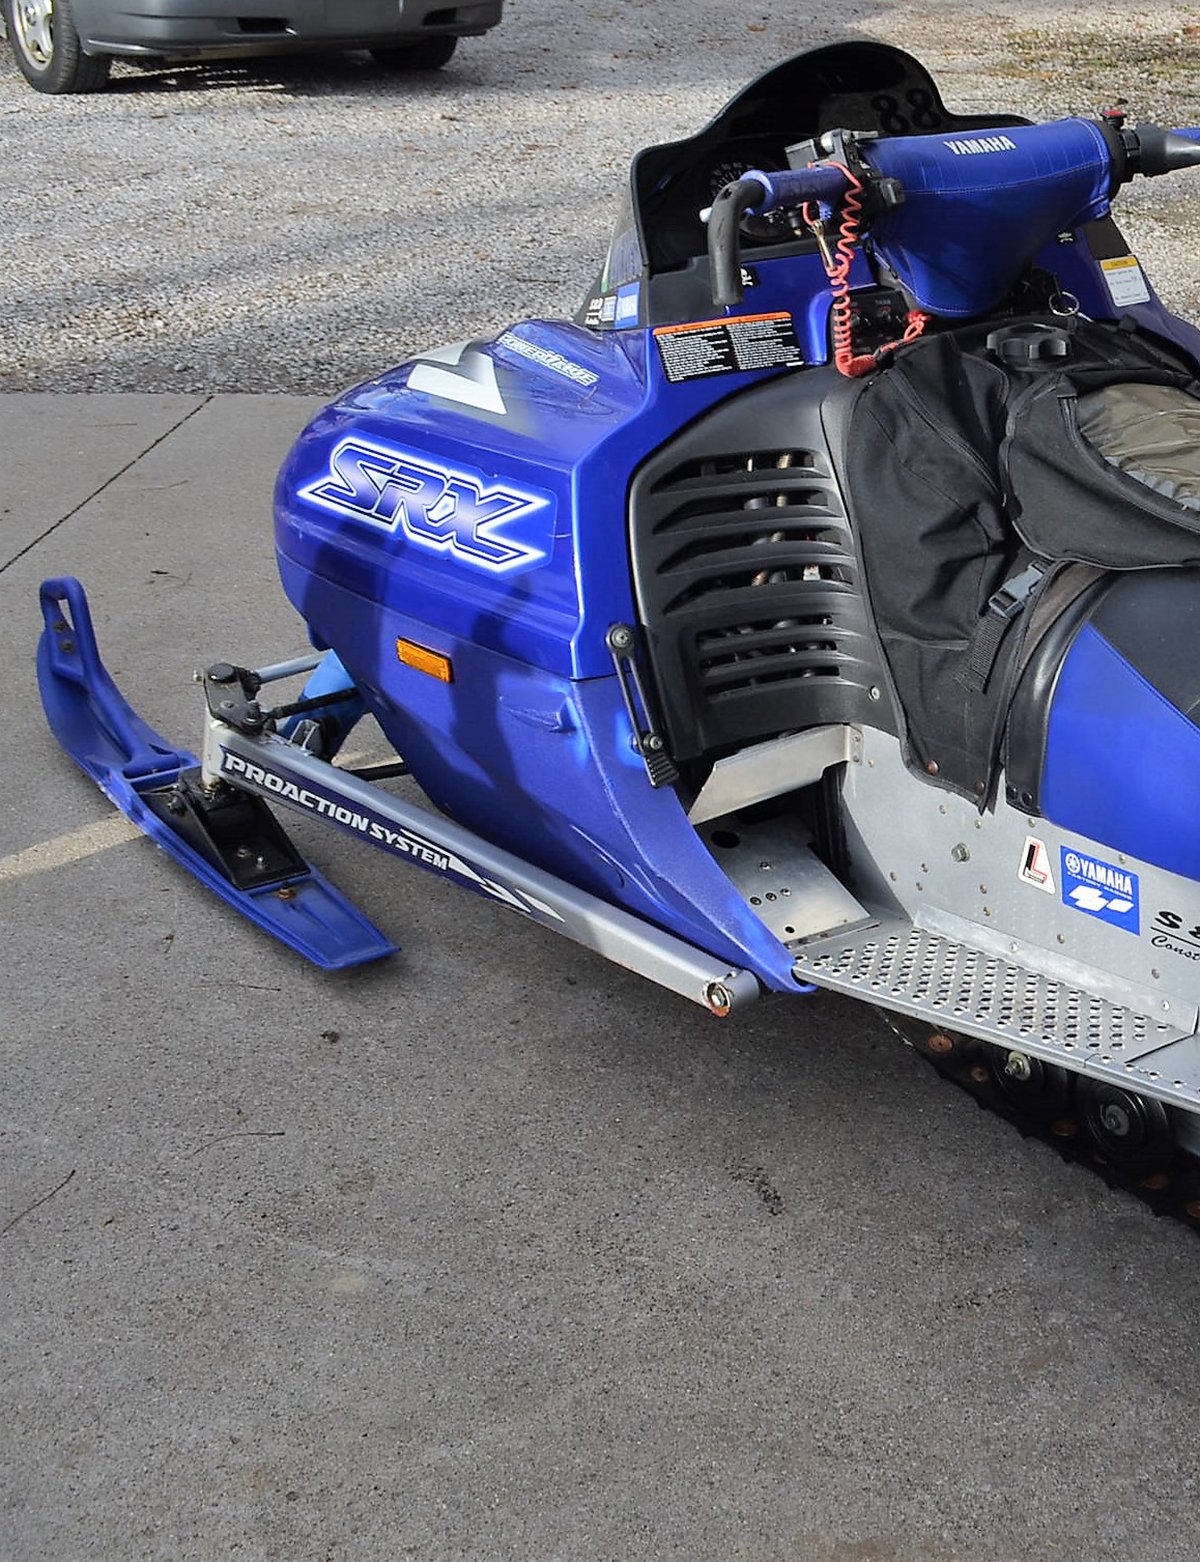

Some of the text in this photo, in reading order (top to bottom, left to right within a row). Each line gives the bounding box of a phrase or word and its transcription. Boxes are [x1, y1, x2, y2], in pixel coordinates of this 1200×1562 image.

[943, 135, 1017, 155] YAMAHA
[299, 440, 548, 572] SRX
[224, 752, 449, 871] PROACTION SYSTEM
[1079, 857, 1134, 896] YAMAHA
